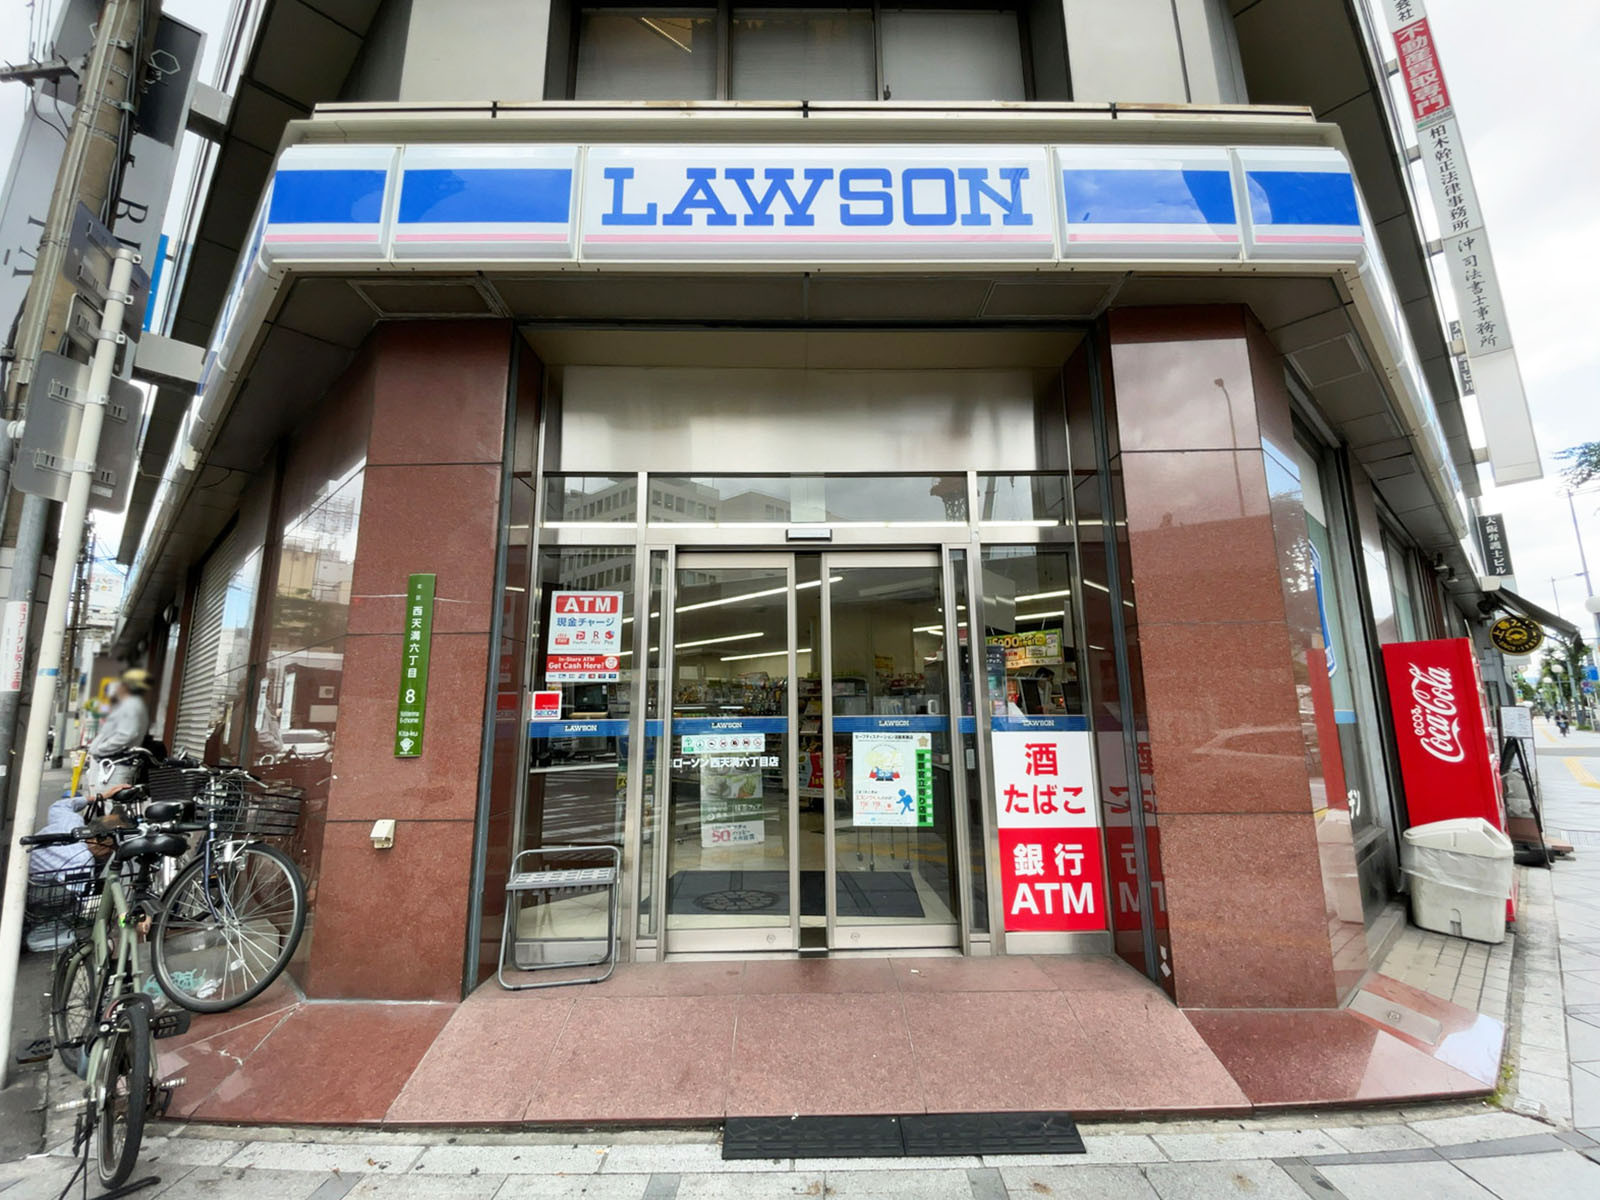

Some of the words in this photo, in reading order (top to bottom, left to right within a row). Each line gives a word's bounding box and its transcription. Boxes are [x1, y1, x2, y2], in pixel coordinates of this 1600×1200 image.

[1429, 124, 1470, 232] 柏木幹正法律事務所
[601, 167, 1034, 227] LAWSON
[1485, 516, 1507, 576] 大阪弁護士ビル
[563, 596, 612, 613] ATM
[556, 616, 616, 628] 現金チャージ
[407, 605, 424, 679] 西天満六丁目
[548, 661, 562, 669] Get
[563, 661, 582, 669] Cash
[583, 661, 605, 669] Here!
[405, 688, 416, 704] 8
[564, 724, 598, 732] LAWSON
[1022, 719, 1055, 727] LAWSON
[673, 756, 780, 769] ローソン西天満六丁目店
[1024, 742, 1060, 778] 酒
[1003, 783, 1087, 816] たばこ
[1013, 843, 1085, 878] 銀行
[1010, 882, 1095, 915] ATM
